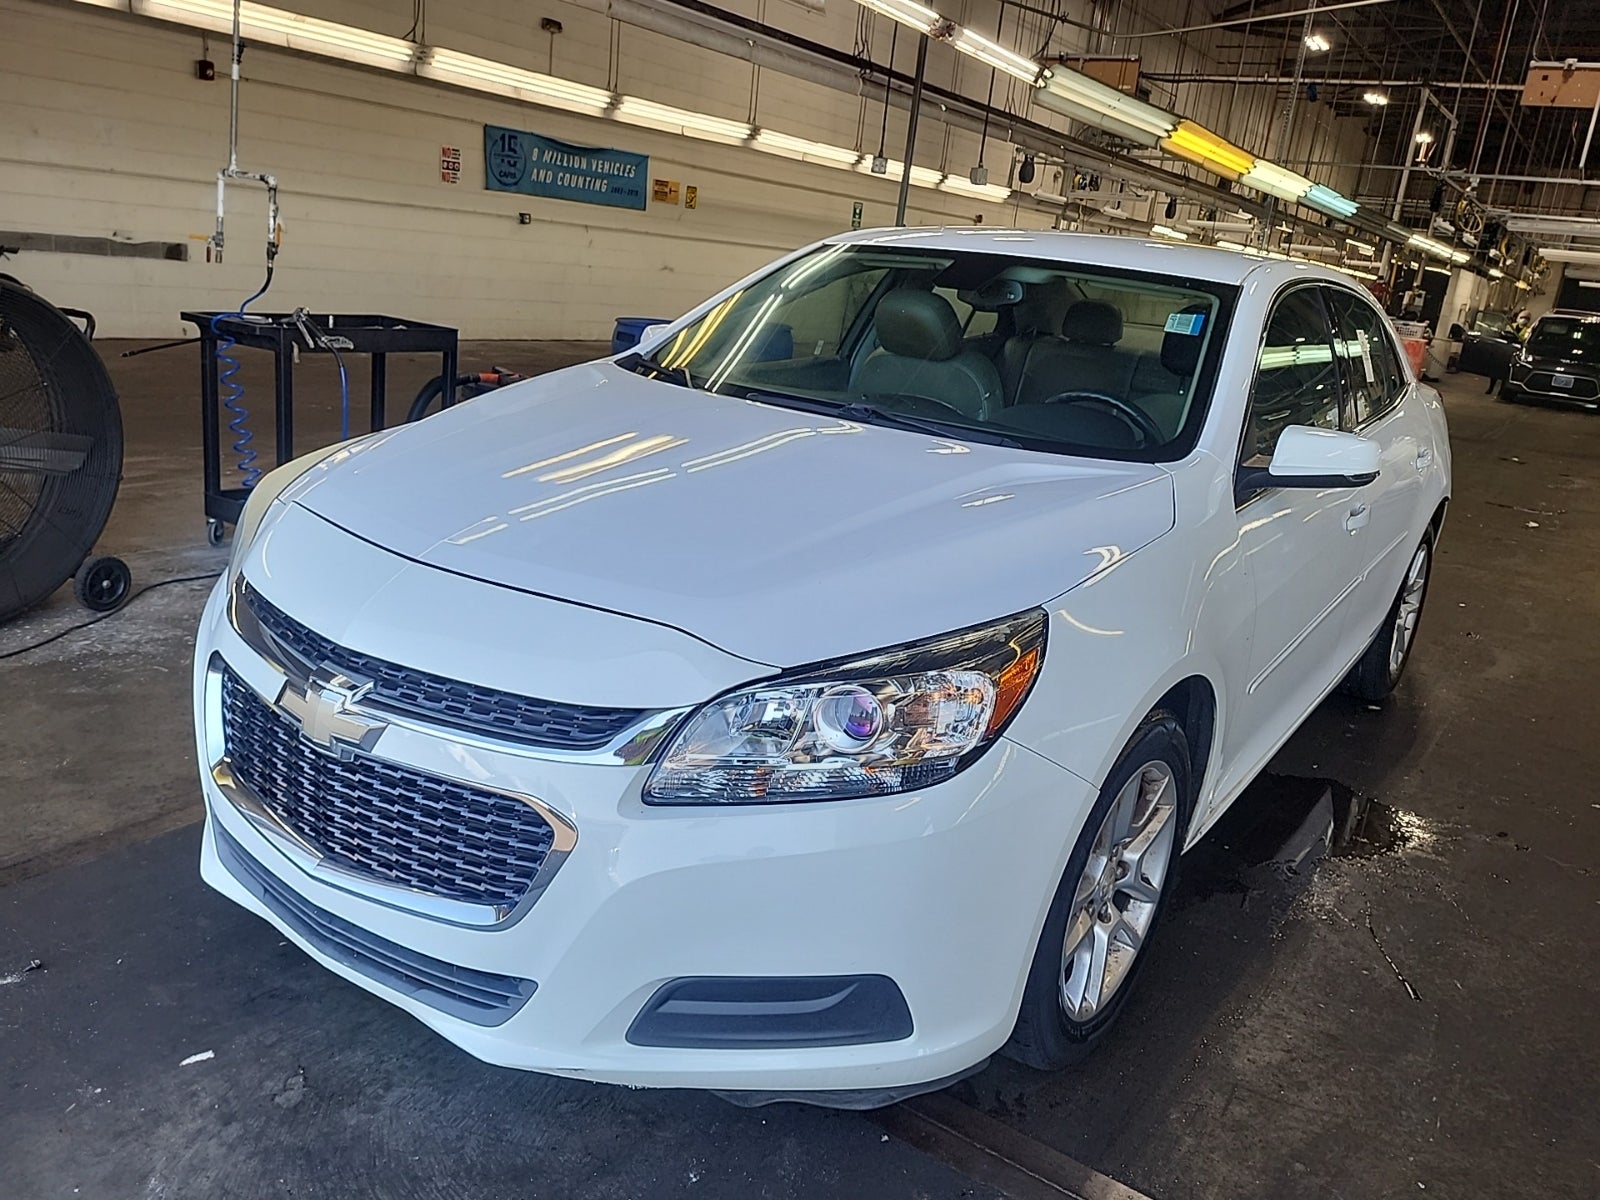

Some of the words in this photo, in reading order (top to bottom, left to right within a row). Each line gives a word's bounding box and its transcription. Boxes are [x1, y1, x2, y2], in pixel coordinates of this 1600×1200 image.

[532, 147, 539, 161] 8
[542, 150, 587, 170] MILLION
[591, 159, 636, 178] VEHICLES
[530, 167, 553, 184] AND
[557, 172, 608, 192] COUNTING
